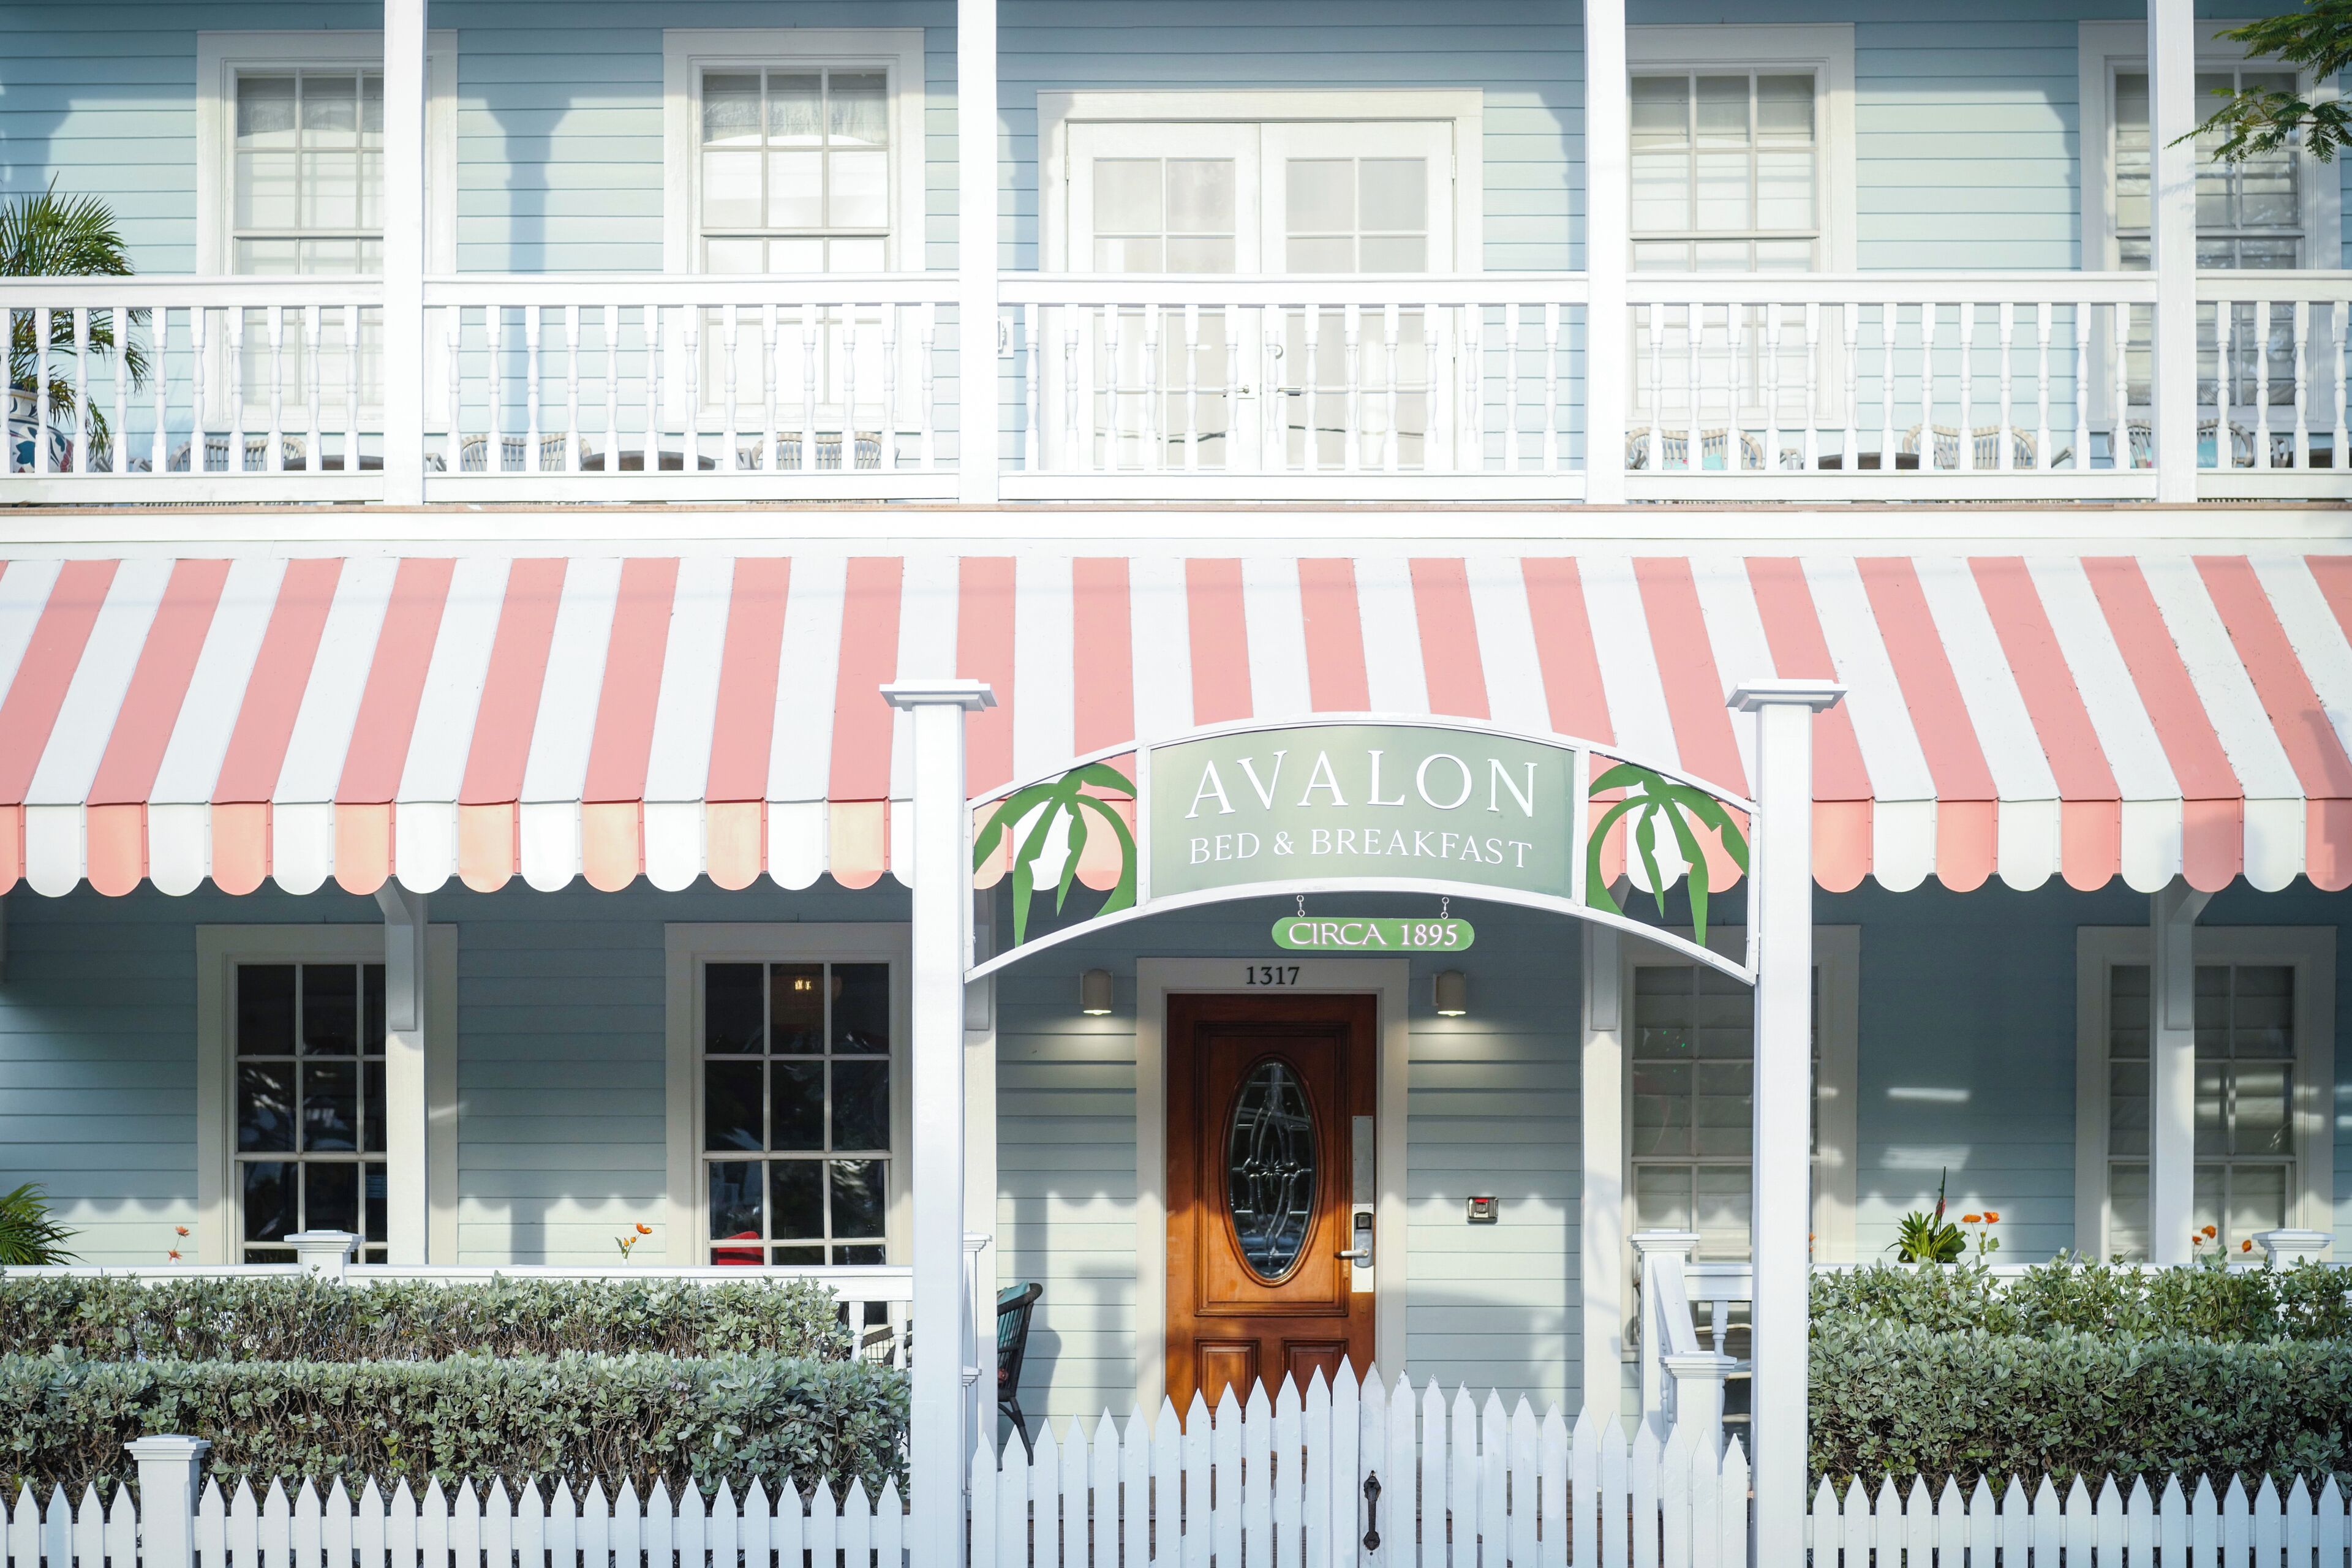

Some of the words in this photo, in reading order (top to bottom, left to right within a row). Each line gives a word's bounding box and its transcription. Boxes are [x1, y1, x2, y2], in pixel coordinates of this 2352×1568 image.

[1185, 750, 1538, 819] AVALON
[1189, 832, 1261, 865] BED
[1273, 831, 1294, 855] &
[1311, 828, 1532, 869] BREAKFAST
[1288, 922, 1388, 946] CIRCA
[1400, 922, 1458, 946] 1895
[1245, 966, 1300, 986] 1317
